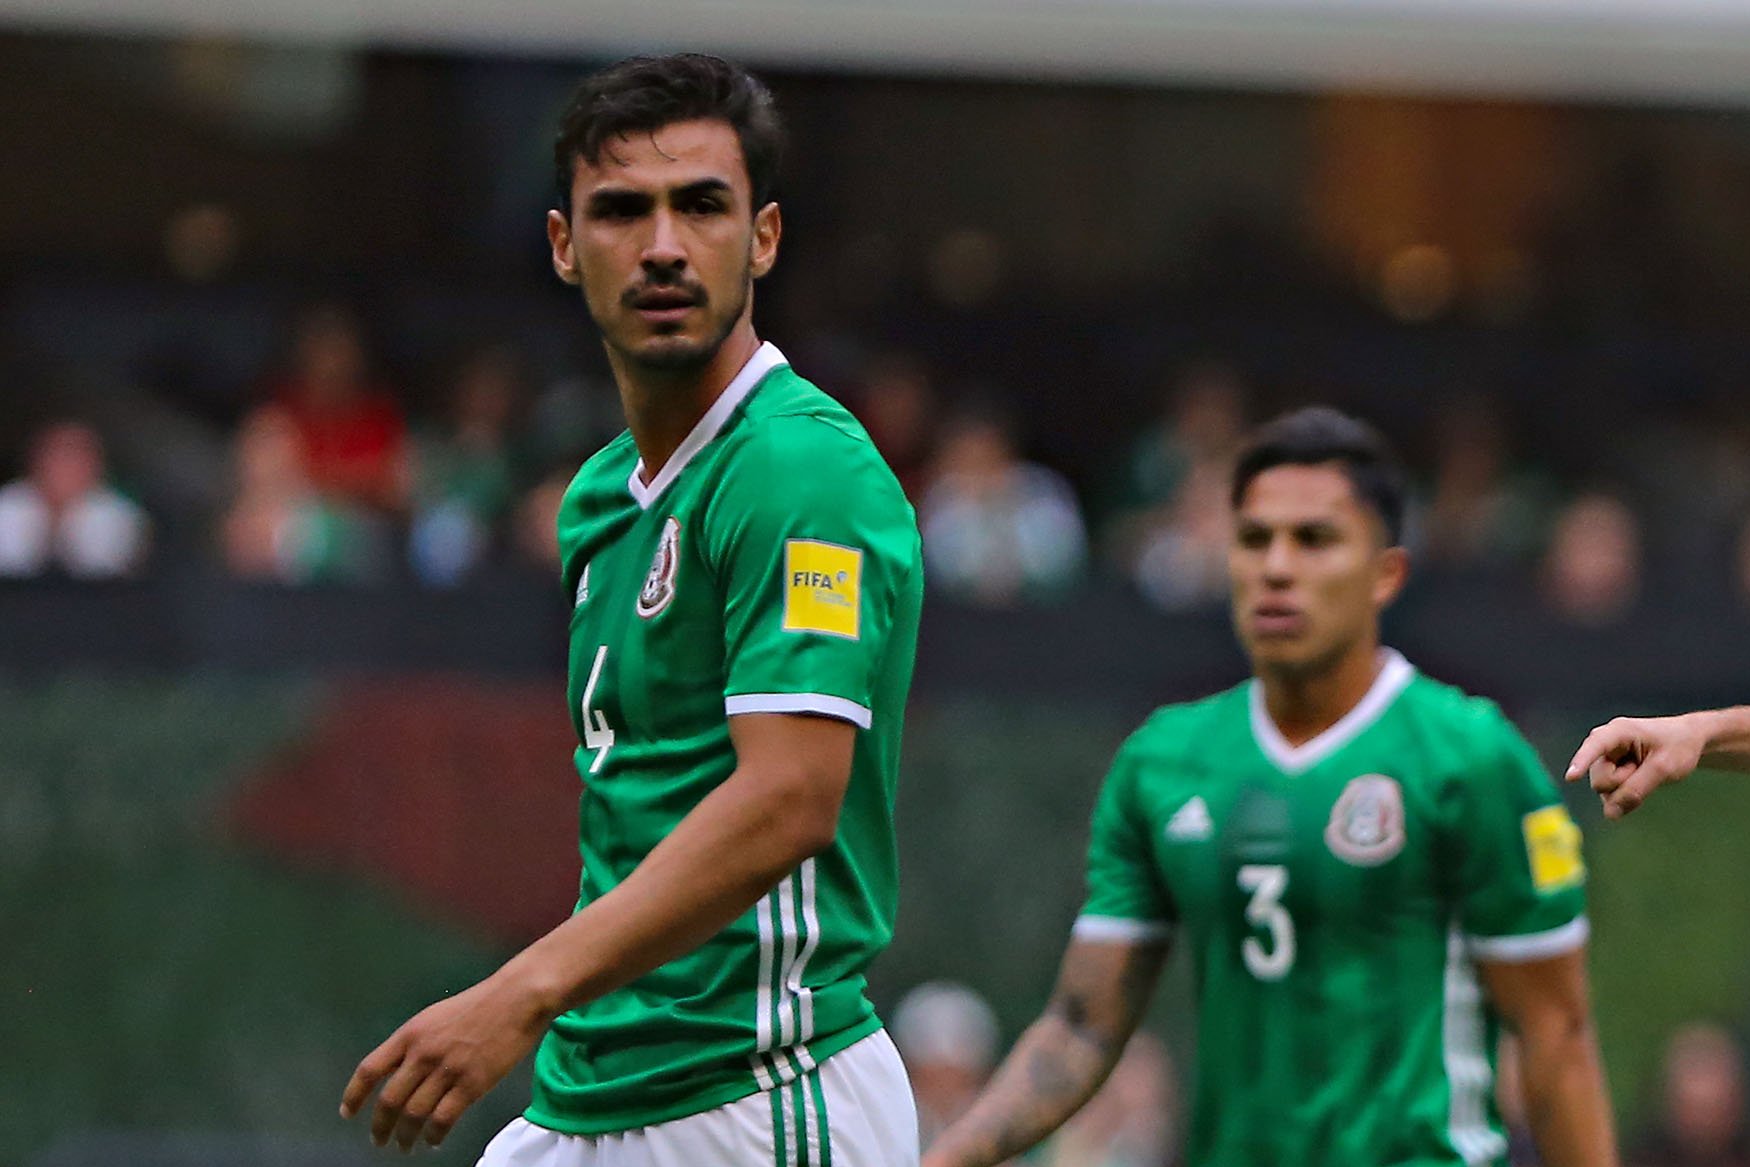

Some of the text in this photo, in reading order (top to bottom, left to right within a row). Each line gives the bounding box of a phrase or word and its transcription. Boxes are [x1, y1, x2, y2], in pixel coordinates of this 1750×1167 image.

[794, 571, 833, 590] FIFA
[582, 645, 615, 774] 4
[1237, 864, 1294, 981] 3
